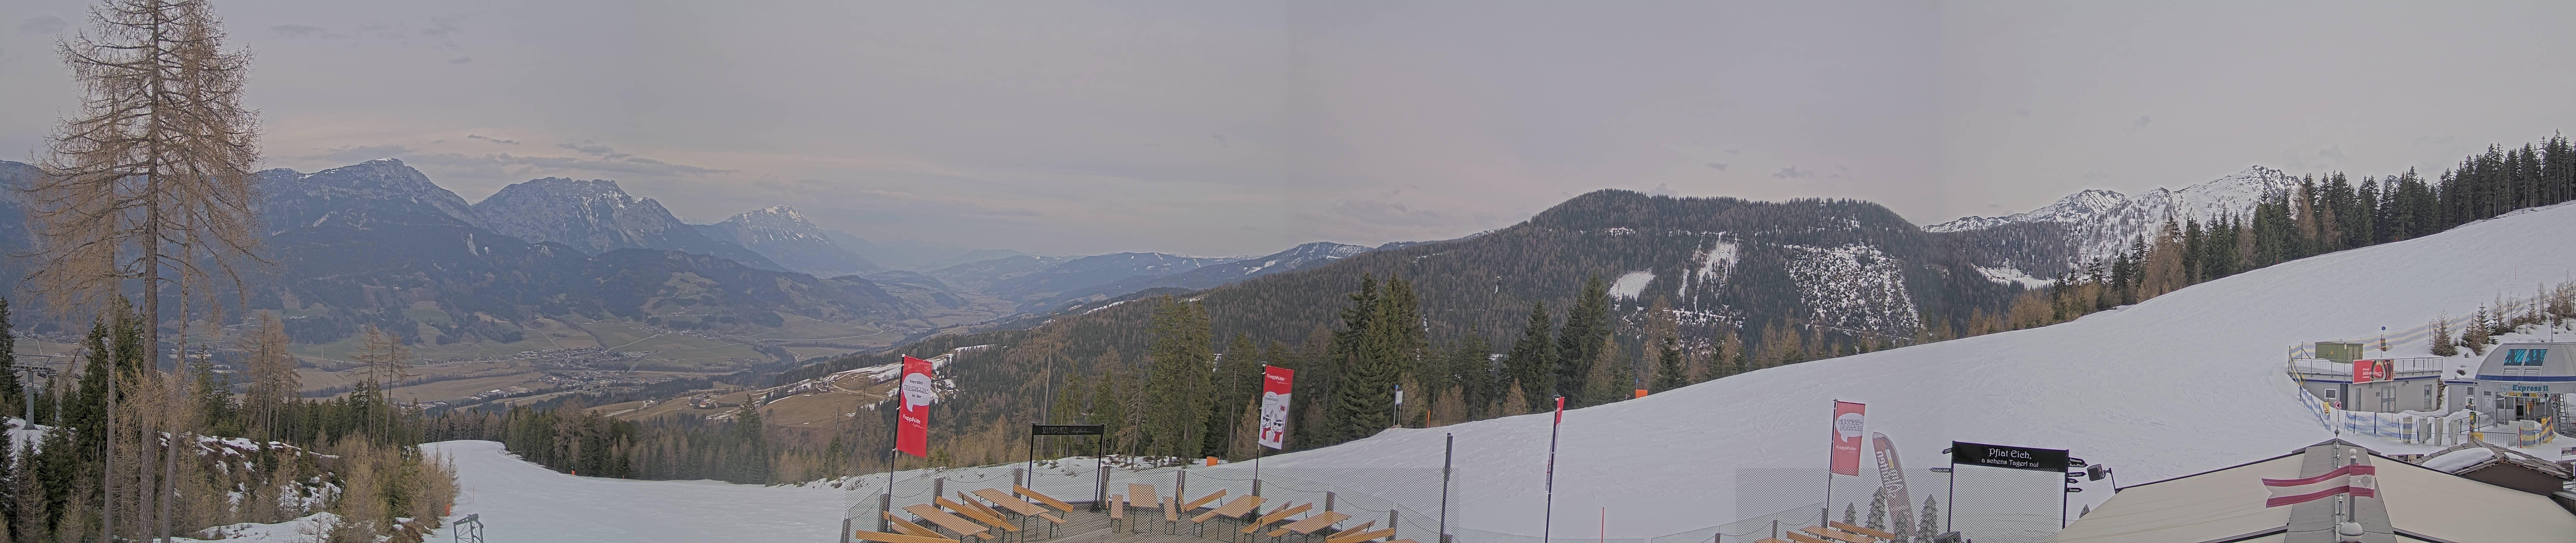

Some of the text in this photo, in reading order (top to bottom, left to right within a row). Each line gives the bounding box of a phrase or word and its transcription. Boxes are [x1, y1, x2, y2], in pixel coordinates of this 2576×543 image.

[903, 413, 921, 424] Knapplhütte
[1989, 448, 2032, 460] Pfiat Eich,
